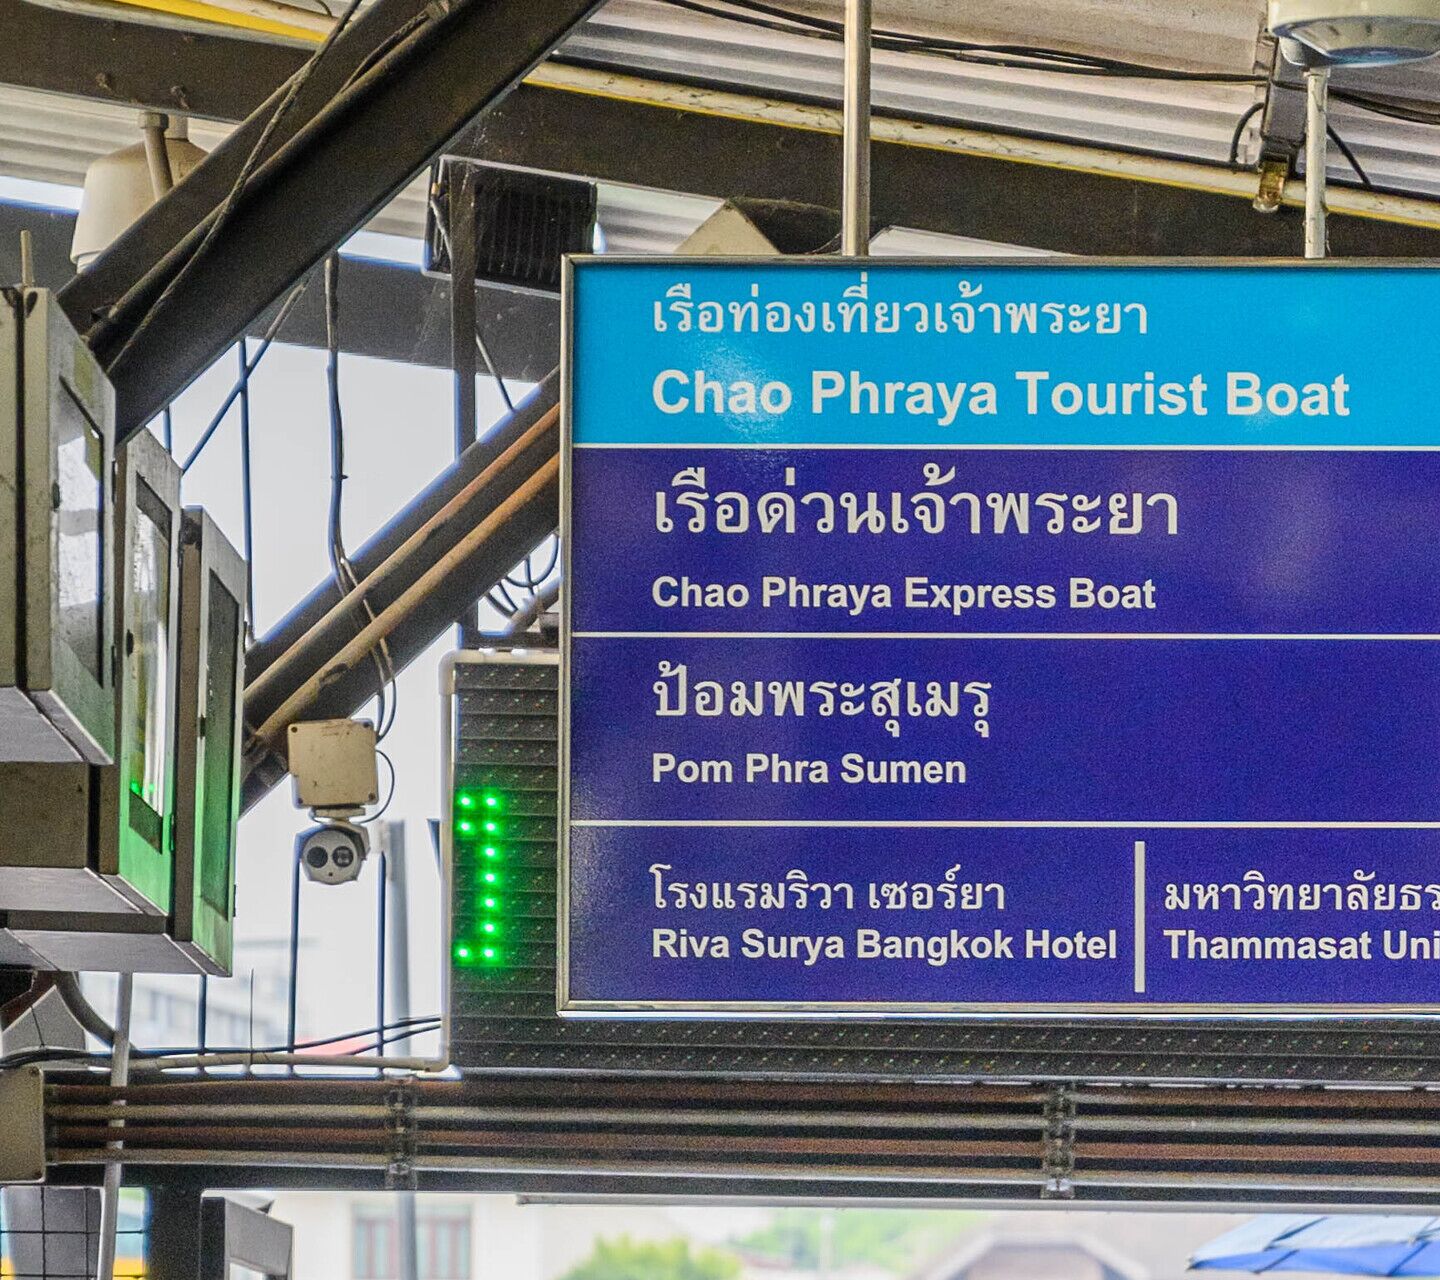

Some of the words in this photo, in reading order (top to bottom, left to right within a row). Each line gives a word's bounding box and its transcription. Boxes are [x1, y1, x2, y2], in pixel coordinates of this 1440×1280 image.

[653, 271, 1148, 335] เรือท่องเที่ยวเจ้าพระยา
[652, 369, 792, 415] Chao
[812, 370, 997, 426] Phraya
[1015, 371, 1208, 416] Tourist
[1226, 371, 1350, 416] Boat
[655, 462, 1179, 536] เรือด่วนเจ้าพระยา
[652, 575, 750, 608] Chao
[762, 576, 892, 616] Phraya
[905, 576, 1057, 616] Express
[1069, 577, 1157, 609] Boat
[652, 660, 993, 738] ป้อมพระสุเมรุ
[652, 752, 733, 783] Pom
[746, 753, 829, 784] Phra
[840, 753, 966, 784] Sumen
[648, 863, 854, 910] โรงแรมริวา
[868, 863, 1006, 911] เซอร์ยา
[652, 928, 730, 959] Riva
[741, 928, 845, 966] Surya
[857, 928, 1014, 967] Bangkok
[1025, 929, 1117, 960] Hotel
[1162, 929, 1372, 960] Thammasat
